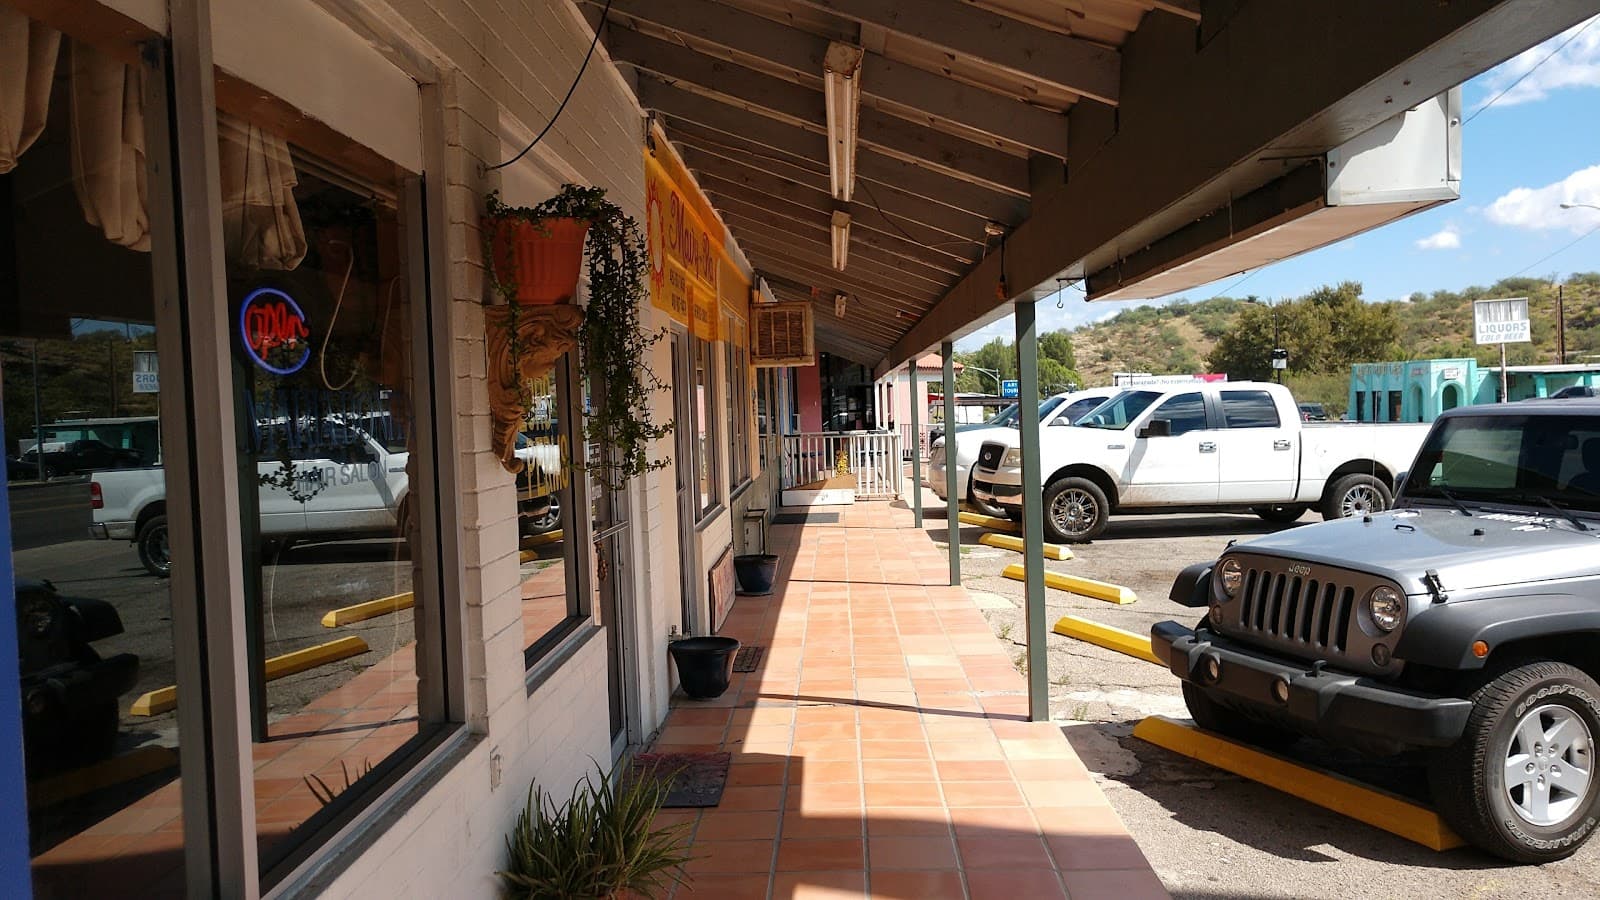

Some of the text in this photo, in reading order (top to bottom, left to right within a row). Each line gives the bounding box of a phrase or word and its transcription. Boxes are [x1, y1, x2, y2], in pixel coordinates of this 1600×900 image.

[1478, 322, 1527, 334] LIQUORS
[340, 459, 388, 487] SALON
[1289, 562, 1311, 576] Jeep
[1503, 816, 1597, 850] WRANGLER
